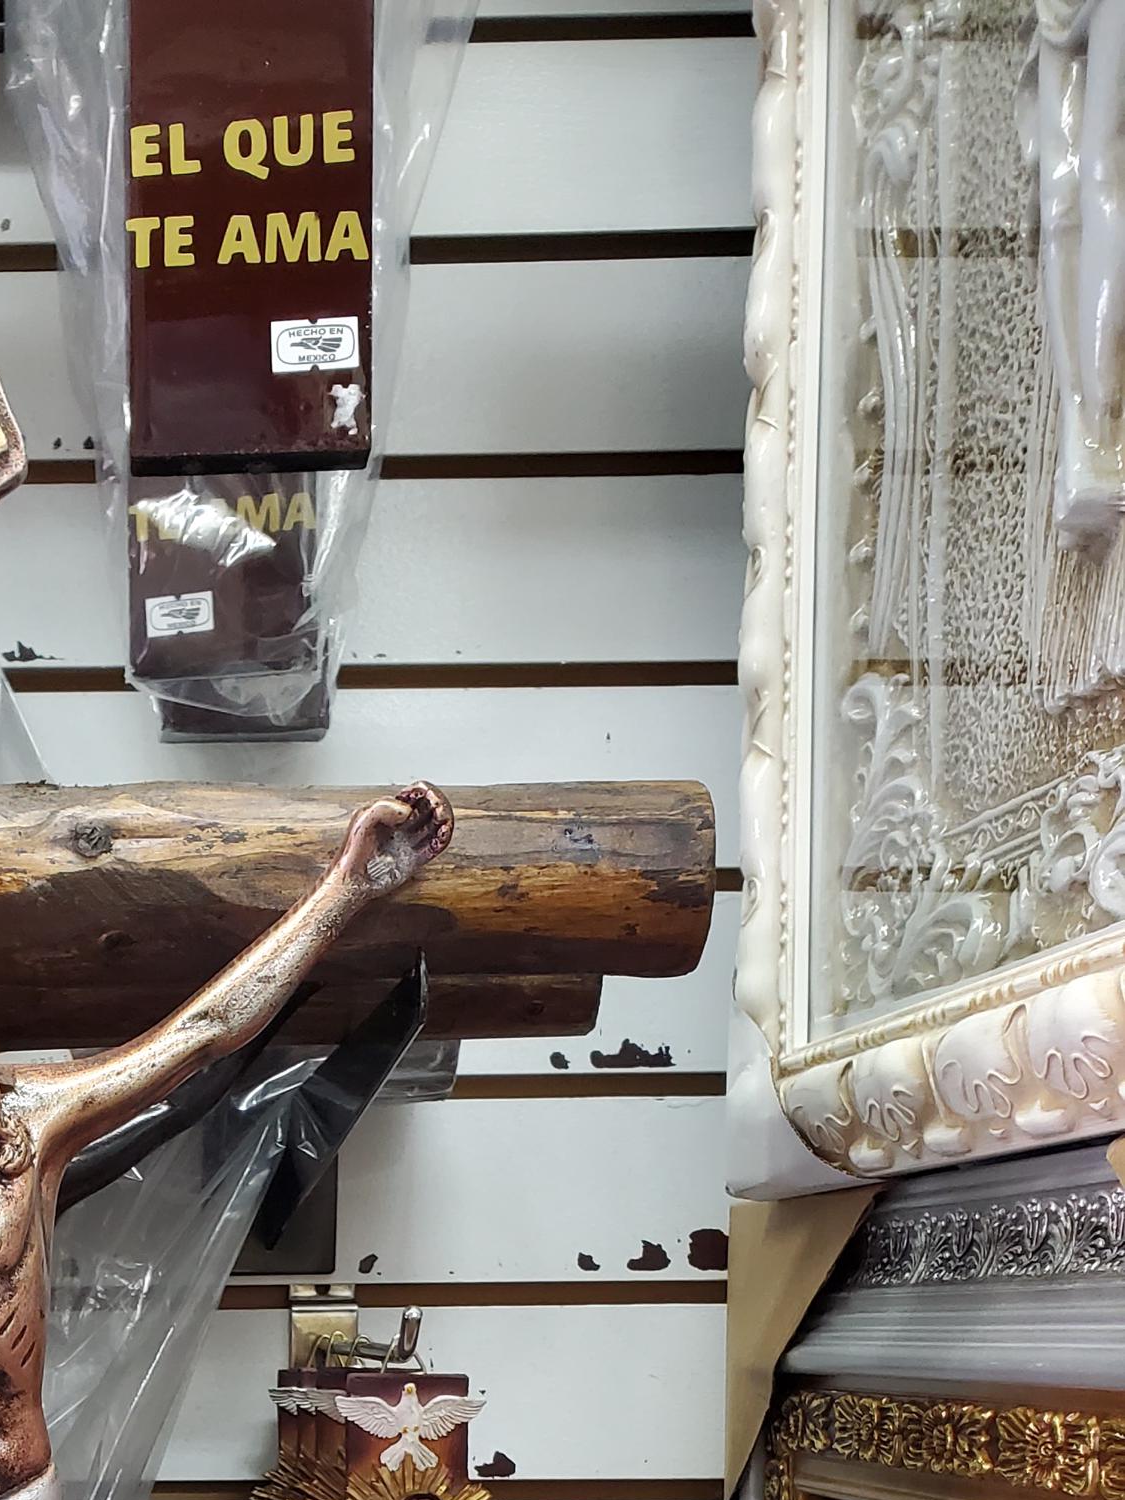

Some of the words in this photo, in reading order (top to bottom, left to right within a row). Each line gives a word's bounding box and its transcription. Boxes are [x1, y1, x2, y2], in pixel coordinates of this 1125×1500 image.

[130, 123, 201, 178] EL
[223, 110, 355, 180] QUE
[125, 216, 195, 268] TE
[218, 211, 369, 265] AMA
[288, 328, 326, 338] HECHO
[329, 327, 344, 335] EN
[209, 492, 317, 538] MA
